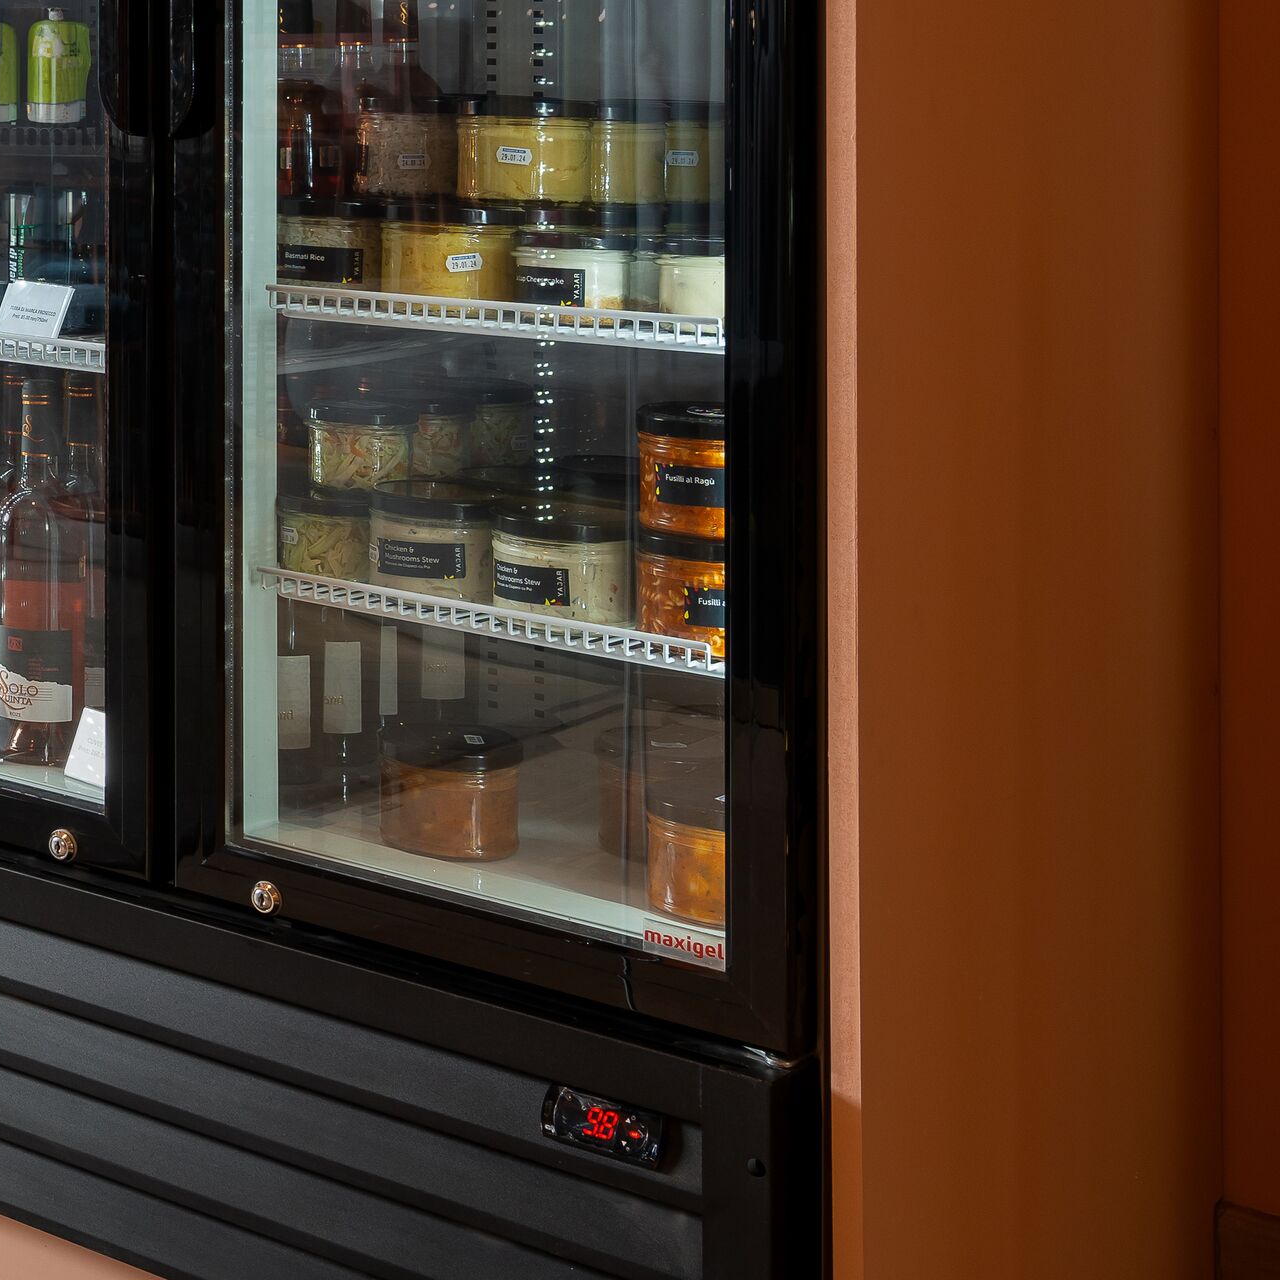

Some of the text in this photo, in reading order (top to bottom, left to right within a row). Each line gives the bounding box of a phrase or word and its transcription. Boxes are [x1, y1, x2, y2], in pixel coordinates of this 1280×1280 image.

[284, 251, 325, 262] Basmati Rice
[665, 474, 684, 482] Fusilli
[694, 477, 715, 486] Ragù
[385, 543, 408, 553] Chicken
[385, 553, 420, 563] Mushrooms
[422, 555, 440, 564] Stew
[496, 564, 512, 573] Chicken
[524, 578, 541, 586] Stew
[698, 598, 721, 606] Fusilli
[0, 670, 39, 696] SOLO
[644, 930, 725, 960] maxigel
